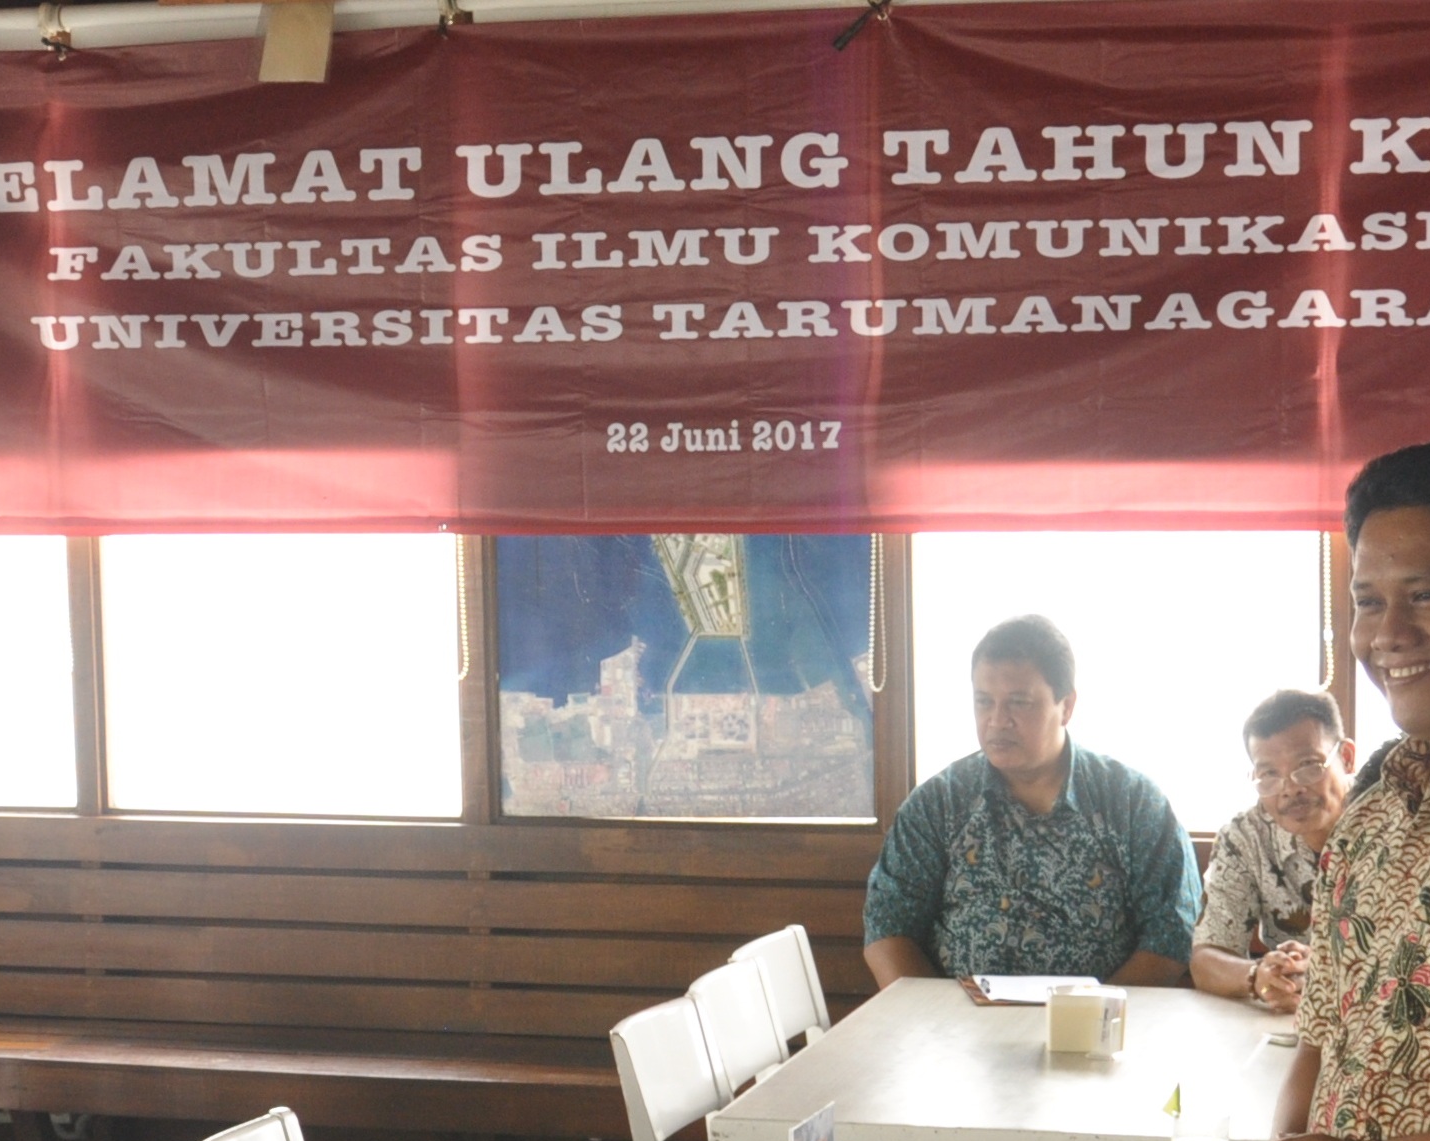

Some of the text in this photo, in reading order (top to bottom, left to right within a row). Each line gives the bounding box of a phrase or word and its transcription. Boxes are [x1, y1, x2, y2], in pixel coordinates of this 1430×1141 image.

[455, 132, 849, 199] ULANG
[883, 119, 1314, 186] TAHUN
[46, 234, 503, 282] FAKULTAS
[531, 226, 781, 271] ILMU
[29, 304, 624, 351] UNIVERSITAS
[606, 419, 843, 454] 22 Juni 2017
